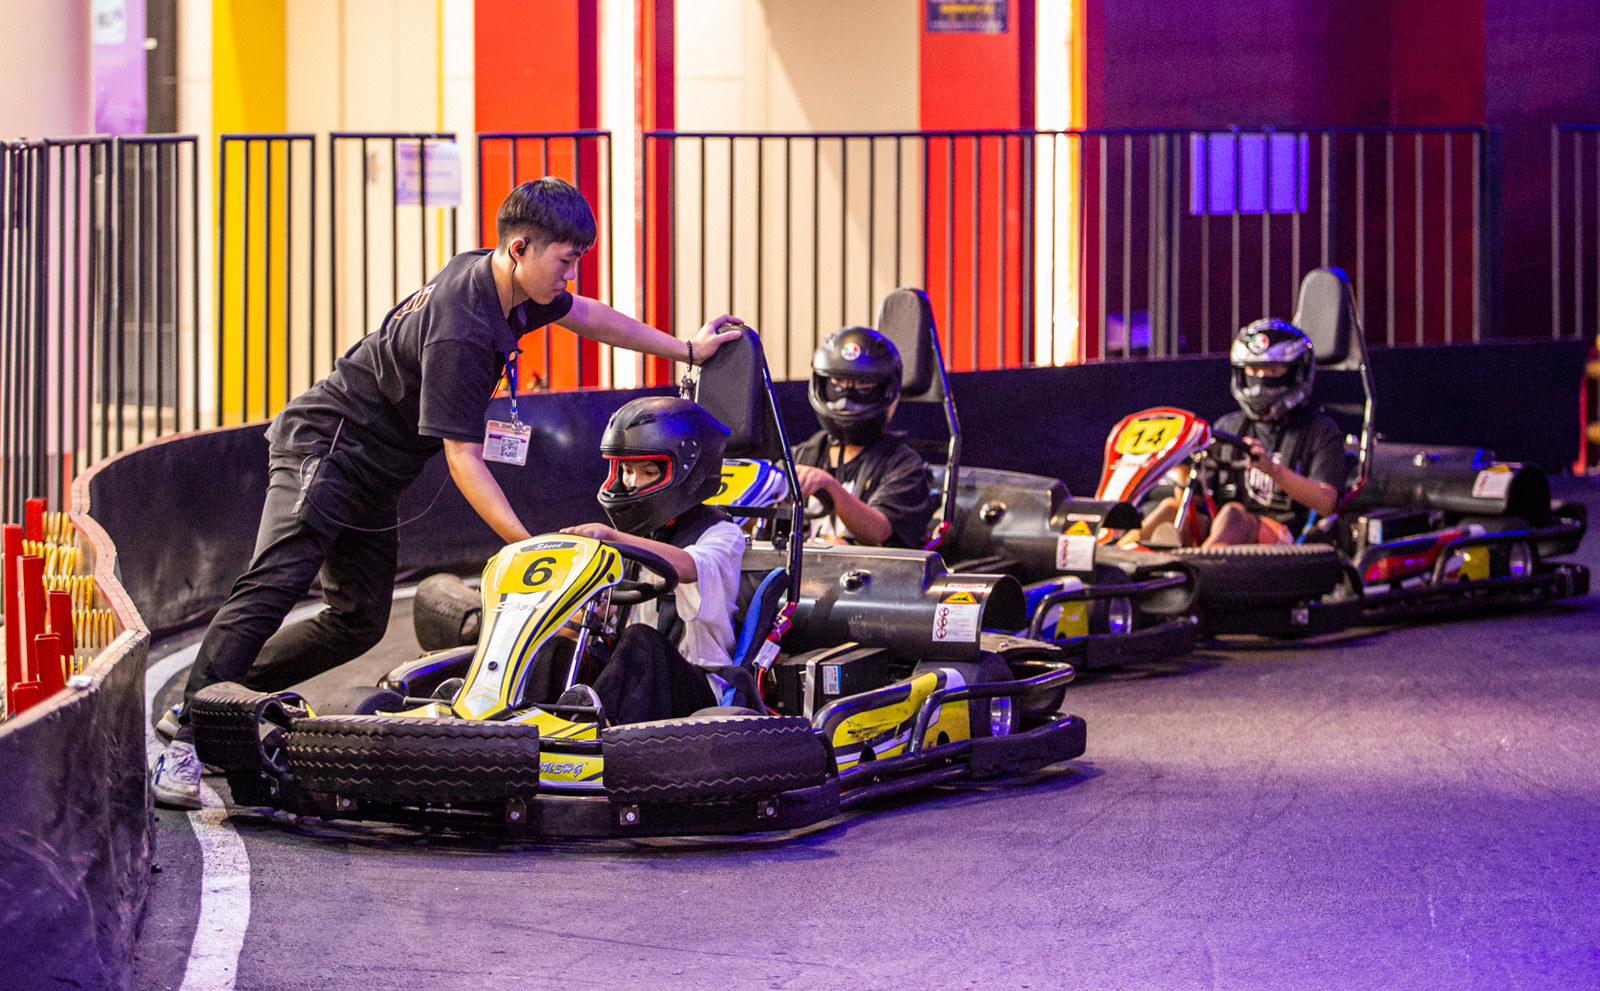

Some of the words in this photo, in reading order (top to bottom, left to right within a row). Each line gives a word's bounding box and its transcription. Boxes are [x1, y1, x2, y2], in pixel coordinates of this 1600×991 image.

[1131, 428, 1166, 447] 14
[534, 542, 563, 551] Speed
[522, 556, 557, 587] 6
